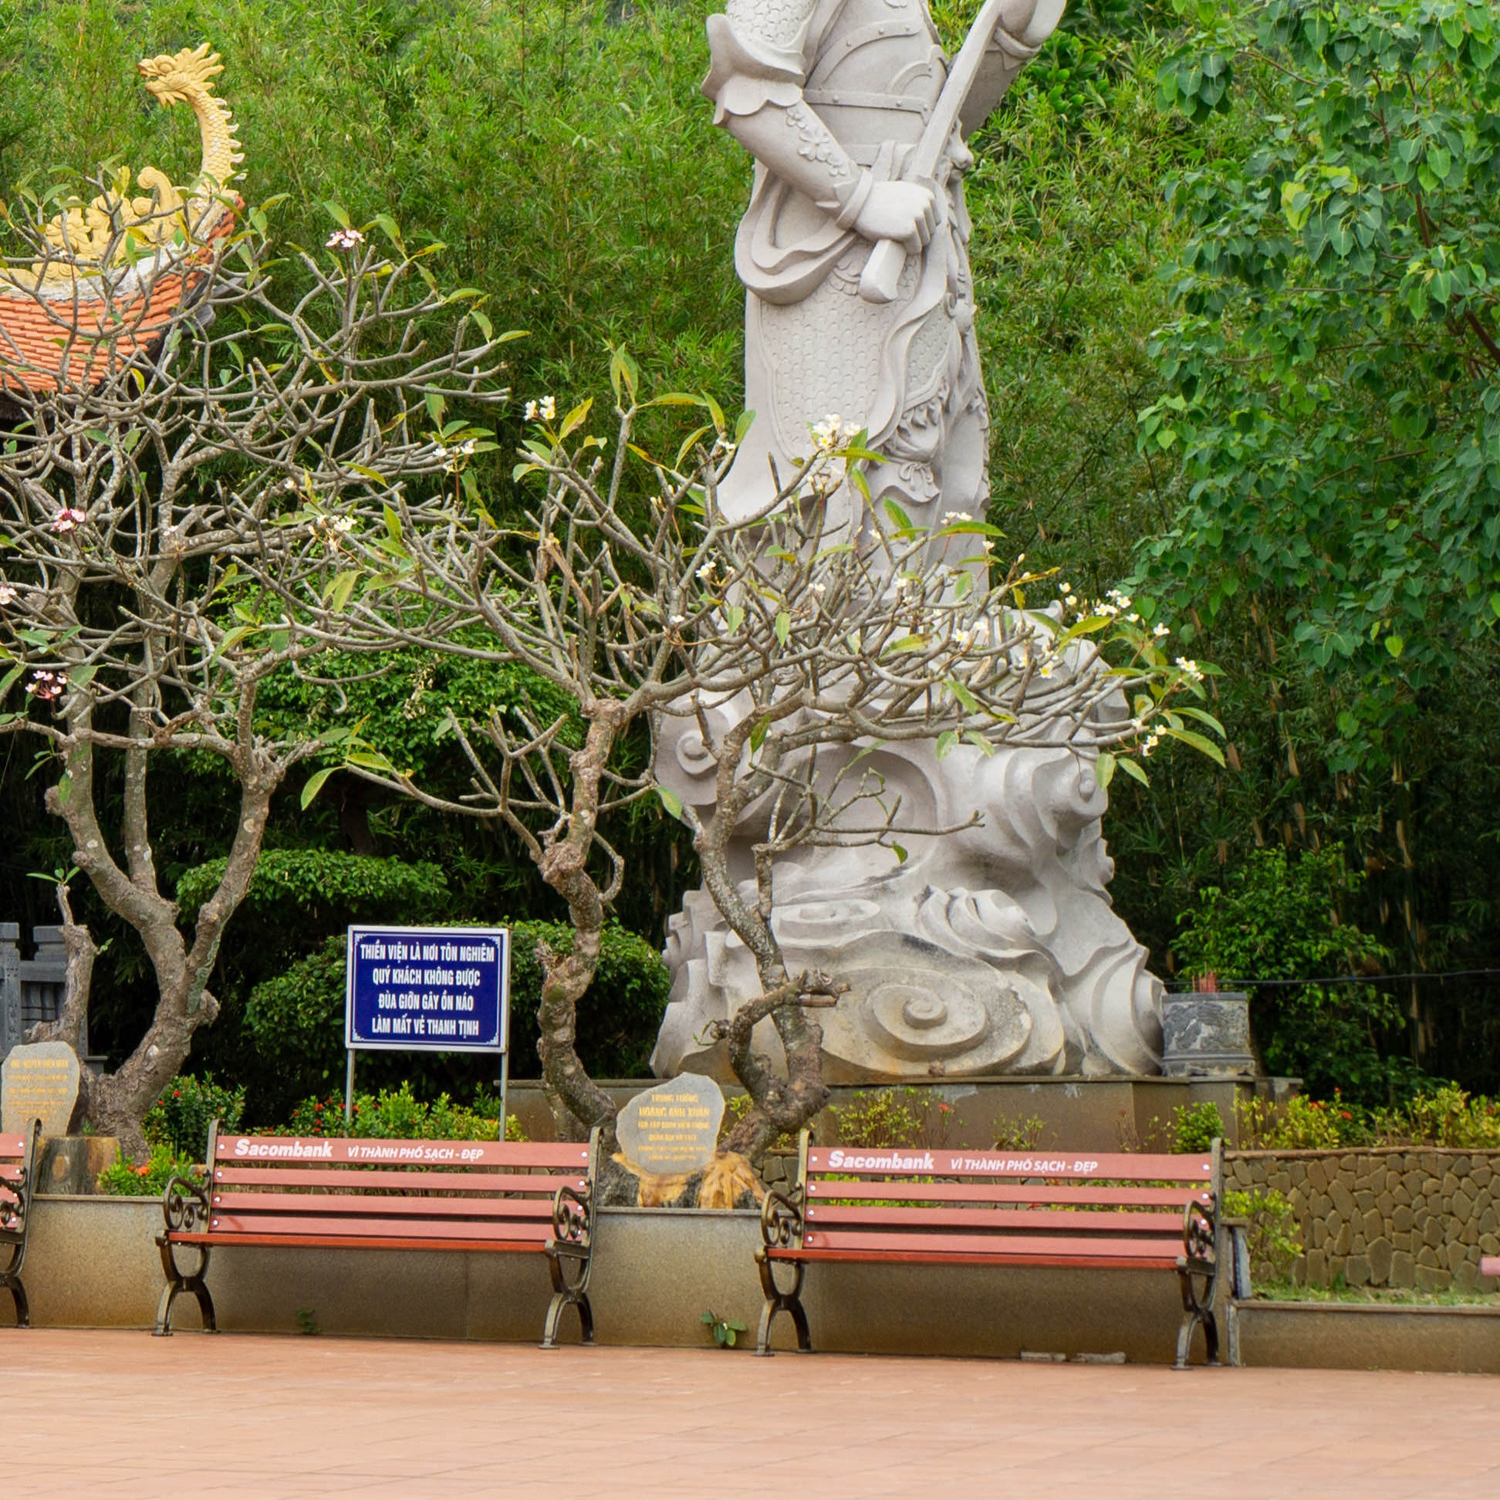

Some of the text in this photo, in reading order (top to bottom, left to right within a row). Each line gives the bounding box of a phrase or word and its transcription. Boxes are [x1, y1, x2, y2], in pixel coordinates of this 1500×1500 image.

[388, 941, 408, 963] VIỆN
[410, 941, 421, 960] LÀ
[423, 943, 438, 960] NƠI
[440, 942, 457, 961] TÔN
[460, 943, 494, 962] NGHIÊM
[373, 965, 480, 989] QUÝ KHÁCH KHÔNG ĐƯỢC
[378, 990, 397, 1009] ĐÙA
[422, 991, 439, 1010] GÂY
[456, 992, 473, 1011] NÁO
[372, 1013, 479, 1039] LÀM MẤT VẺ THANH TỊNH
[235, 1139, 333, 1157] Sacombank
[348, 1146, 359, 1157] VÌ
[361, 1146, 398, 1158] THÀNH
[399, 1145, 423, 1159] PHỐ
[425, 1149, 453, 1160] SẠCH
[461, 1150, 483, 1161] ĐẸP
[829, 1150, 933, 1170] Sacombank
[951, 1158, 963, 1170] VÌ
[965, 1158, 1005, 1171] THÀNH
[1006, 1157, 1032, 1171] PHỐ
[1034, 1162, 1065, 1173] SẠCH
[1074, 1162, 1097, 1174] ĐẸP
